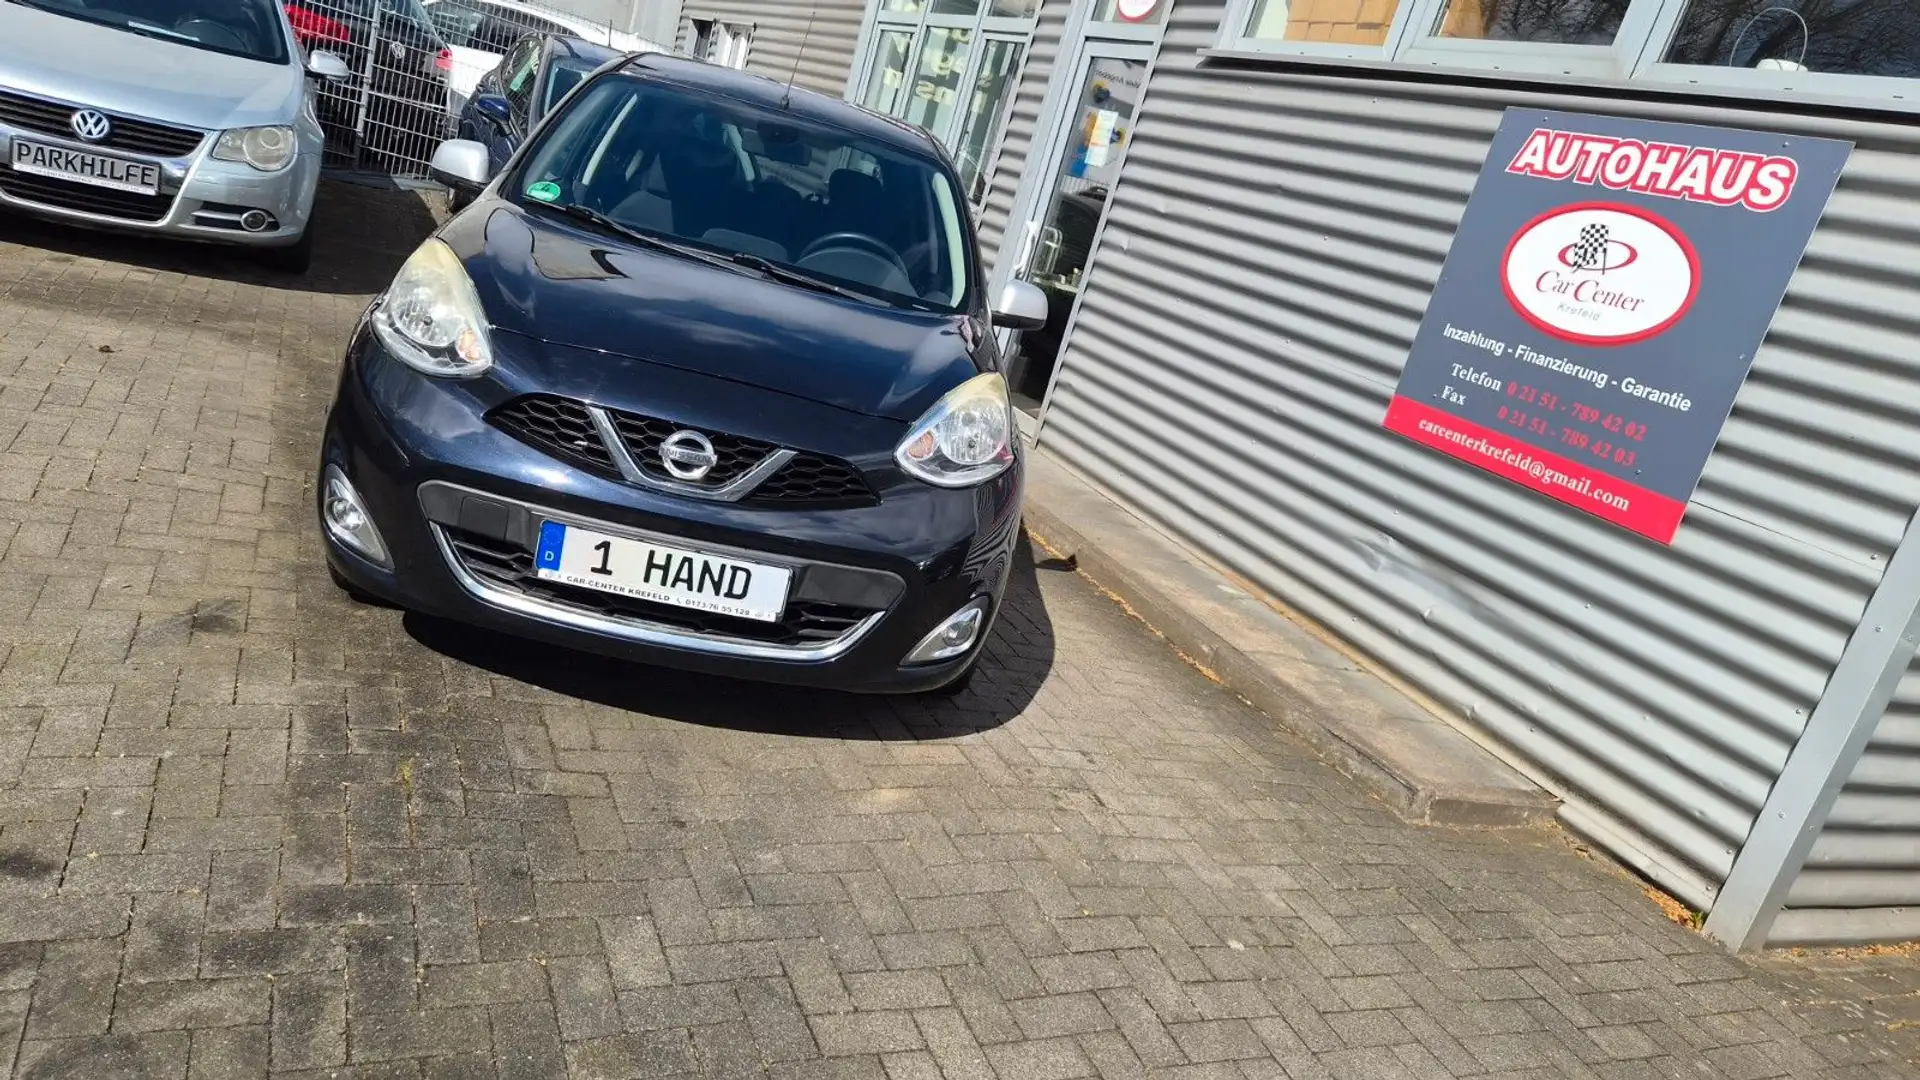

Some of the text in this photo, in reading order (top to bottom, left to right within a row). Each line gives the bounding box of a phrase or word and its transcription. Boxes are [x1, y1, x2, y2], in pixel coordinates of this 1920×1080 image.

[16, 142, 155, 186] PARKHILFE
[1507, 129, 1798, 211] AUTOHAUS
[1557, 302, 1601, 321] Krefeld
[1443, 323, 1505, 357] Inzahlung
[1514, 344, 1609, 389] Finanzierung
[1621, 377, 1692, 412] Garantie
[1442, 385, 1467, 406] Fax
[1497, 406, 1508, 420] 0
[1509, 410, 1527, 427] 21
[1528, 417, 1548, 435] 51
[1560, 427, 1589, 448] 789
[1591, 439, 1612, 458] 42
[1614, 447, 1636, 466] 03
[1451, 363, 1502, 392] Telefon
[1507, 381, 1517, 396] 0
[1519, 385, 1537, 403] 21
[1538, 392, 1557, 411] 51
[1572, 402, 1600, 423] 789
[1602, 413, 1623, 432] 42
[1624, 421, 1647, 441] 02
[666, 447, 713, 465] NISSAN
[1419, 418, 1630, 512] carcenterkrefeld@gmail.com
[545, 551, 554, 561] D
[590, 540, 752, 600] 1 HAND
[628, 588, 670, 601] KREFELD
